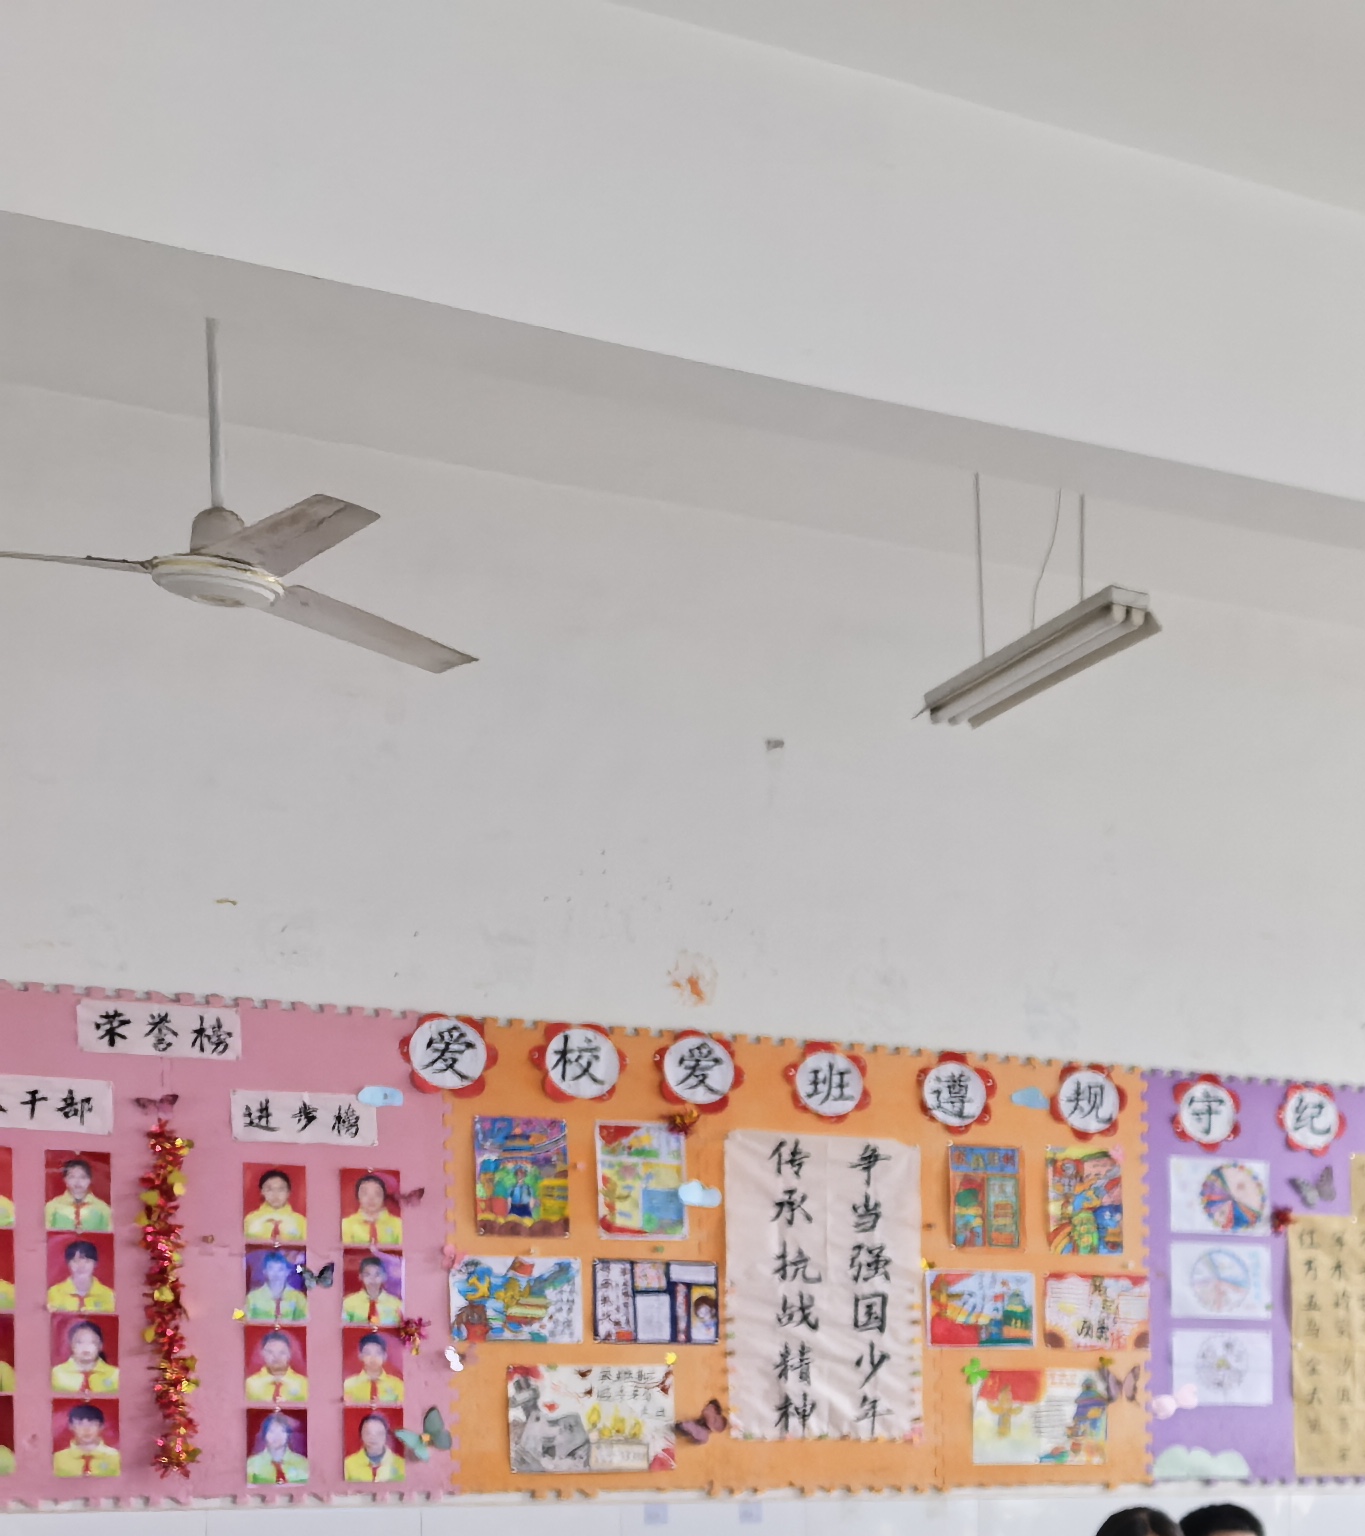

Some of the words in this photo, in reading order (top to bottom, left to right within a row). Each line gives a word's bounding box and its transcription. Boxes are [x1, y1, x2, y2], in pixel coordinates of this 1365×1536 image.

[94, 1009, 234, 1056] 荣誉榜
[0, 1089, 93, 1126] 干部
[243, 1100, 361, 1139] 进步榜
[768, 1138, 822, 1434] 传承抗战精神
[848, 1142, 892, 1435] 争当强国少年
